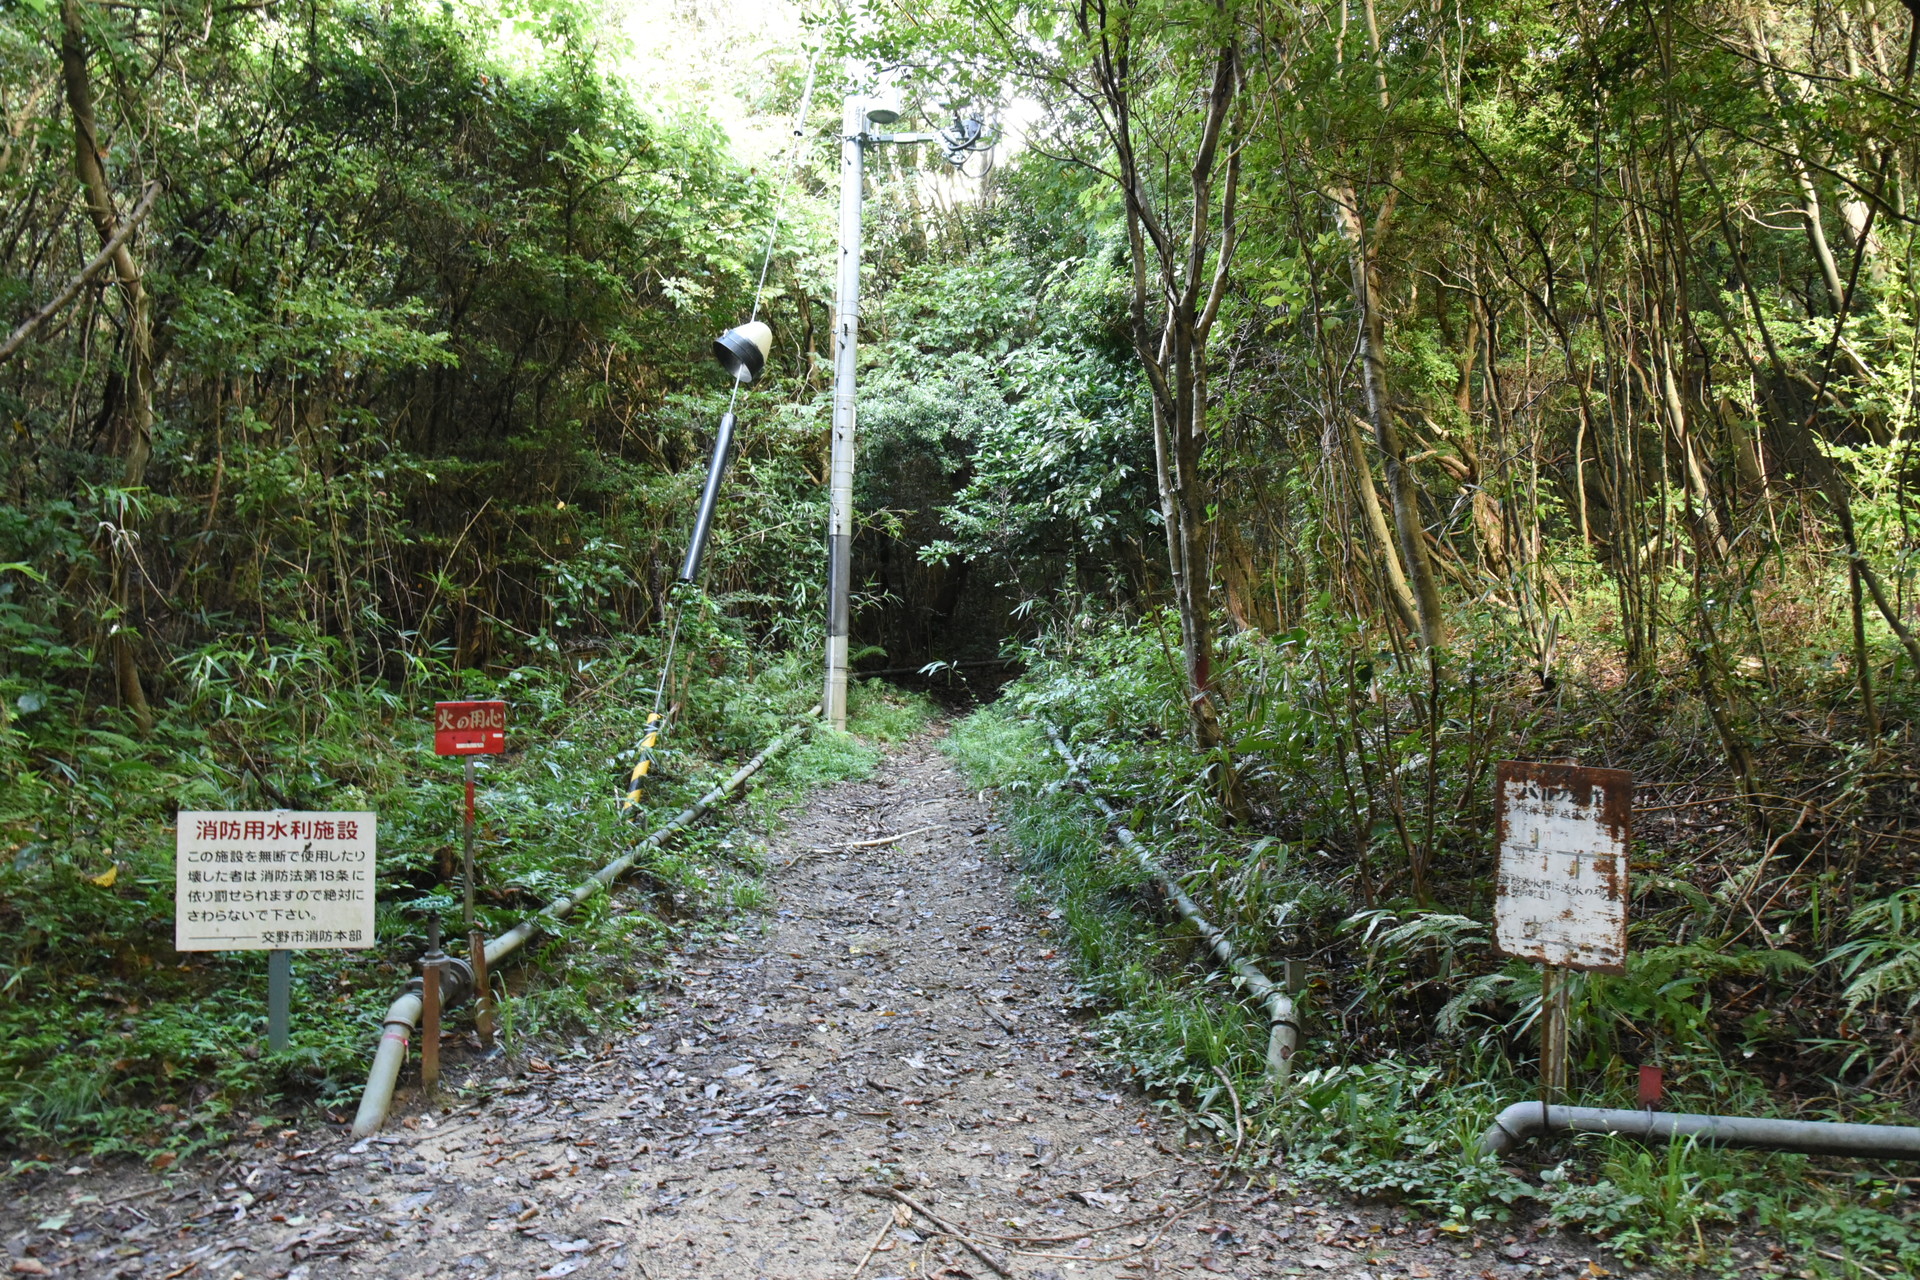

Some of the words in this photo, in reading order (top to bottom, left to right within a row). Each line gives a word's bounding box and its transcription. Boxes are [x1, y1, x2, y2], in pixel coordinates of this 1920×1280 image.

[438, 708, 502, 731] 火の用心
[196, 820, 359, 841] 消防用水利施設
[187, 849, 366, 863] この施設を無断で使用したり
[187, 888, 365, 903] 依り罰せられますので絶対に
[187, 908, 317, 922] さわらないで下さい。
[261, 929, 362, 943] 交野市消防本部
